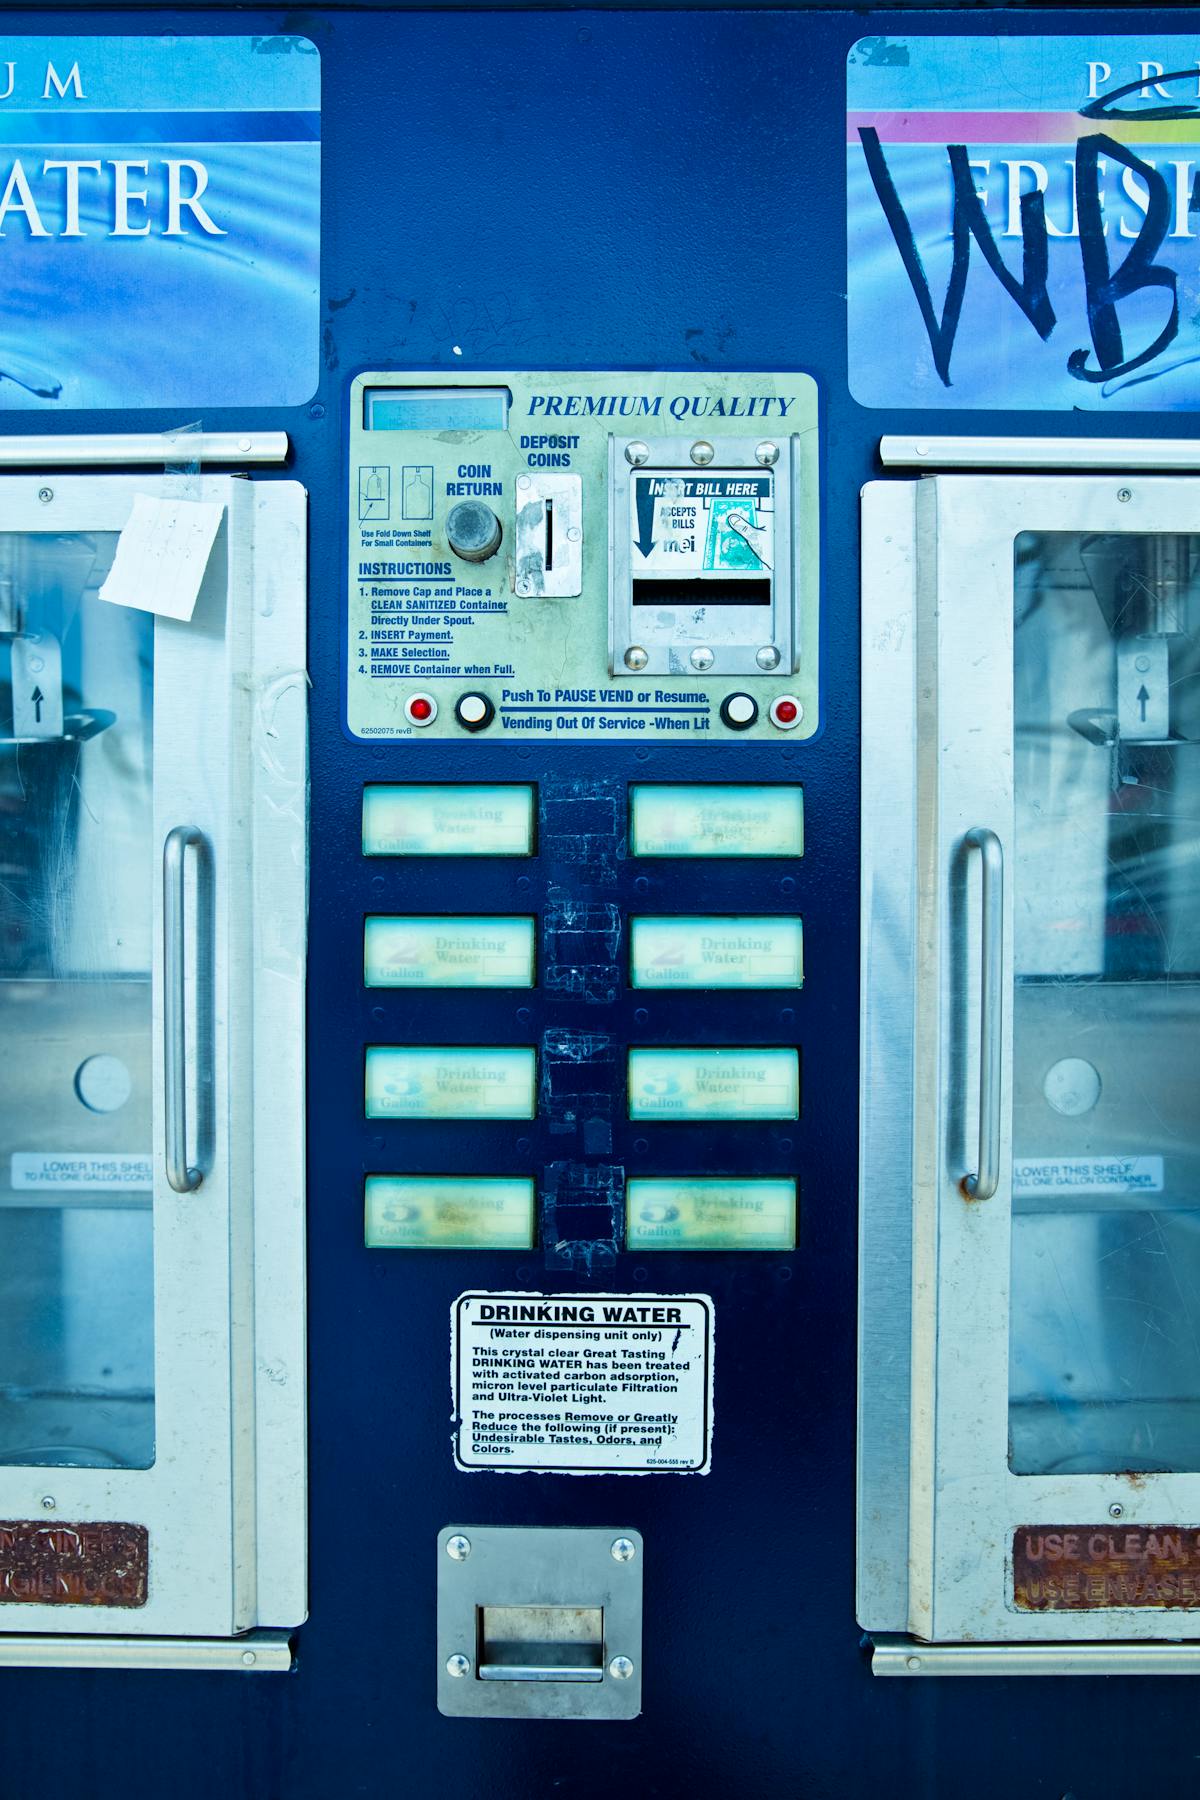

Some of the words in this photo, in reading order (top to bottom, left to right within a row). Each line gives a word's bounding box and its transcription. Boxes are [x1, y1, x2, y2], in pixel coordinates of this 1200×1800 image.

[1086, 61, 1200, 98] PR
[527, 396, 664, 416] PREMIUM
[669, 396, 796, 421] QUALITY
[521, 435, 579, 448] DEPOSIT
[528, 453, 570, 466] COINS
[458, 465, 491, 478] COIN
[447, 483, 502, 496] RETURN
[696, 483, 722, 495] BILL
[726, 483, 758, 495] HERE
[672, 519, 695, 529] BILLS
[663, 536, 695, 553] mei
[359, 563, 451, 575] INSTRUCTIONS
[360, 587, 368, 596] 1.
[372, 587, 410, 596] Remove
[413, 587, 431, 598] Cap
[435, 587, 452, 596] and
[456, 587, 482, 596] Place
[371, 600, 402, 609] CLEAN
[406, 600, 456, 609] SANITIZED
[460, 600, 507, 611] Container
[371, 616, 408, 626] Directly
[412, 616, 440, 624] Under
[444, 616, 474, 626] Spout.
[359, 631, 367, 639] 2.
[371, 630, 405, 639] INSERT
[409, 631, 453, 642] Payment.
[359, 648, 367, 657] 3.
[371, 648, 398, 657] MAKE
[402, 648, 449, 657] Selection.
[359, 665, 367, 673] 4.
[371, 665, 410, 673] REMOVE
[414, 665, 461, 673] Container
[464, 665, 490, 673] when
[494, 665, 515, 673] Full.
[503, 690, 533, 702] Push
[537, 690, 550, 701] To
[555, 690, 596, 702] PAUSE
[599, 690, 633, 702] VEND
[638, 693, 651, 702] or
[655, 691, 709, 703] Resume.
[502, 717, 552, 731] Vending
[557, 717, 578, 729] Out
[582, 717, 595, 729] Of
[599, 717, 645, 729] Service
[650, 717, 690, 729] -When
[694, 718, 710, 729] Lit
[435, 937, 506, 953] Drinking
[701, 937, 772, 953] Drinking
[436, 951, 480, 964] Water
[702, 952, 746, 965] Water
[379, 966, 424, 979] Gallon
[645, 967, 689, 980] Gallon
[435, 1066, 507, 1083] Drinking
[695, 1066, 765, 1083] Drinking
[436, 1081, 480, 1094] Water
[696, 1081, 740, 1093] Water
[639, 1096, 683, 1109] Gallon
[43, 1161, 87, 1172] LOWER
[91, 1162, 116, 1172] THIS
[1015, 1167, 1059, 1177] LOWER
[1063, 1165, 1089, 1175] THIS
[1093, 1164, 1133, 1174] SHELF
[636, 1225, 681, 1238] Gallon
[478, 1303, 594, 1323] DRINKING
[603, 1307, 681, 1322] WATER
[490, 1329, 530, 1339] (Water
[534, 1327, 602, 1341] dispensing
[605, 1331, 627, 1339] unit
[632, 1331, 661, 1342] only)
[473, 1347, 498, 1356] This
[500, 1349, 544, 1360] crystal
[549, 1349, 579, 1357] clear
[583, 1349, 616, 1358] Great
[621, 1350, 665, 1360] Tasting
[473, 1358, 535, 1368] DRINKING
[539, 1360, 582, 1368] WATER
[587, 1361, 607, 1369] has
[612, 1361, 641, 1369] been
[646, 1362, 689, 1370] treated
[473, 1370, 498, 1378] with
[503, 1371, 560, 1379] activated
[564, 1372, 606, 1380] carbon
[610, 1372, 678, 1384] adsorption,
[473, 1381, 513, 1390] micron
[518, 1382, 546, 1390] level
[551, 1383, 617, 1392] particulate
[622, 1383, 677, 1392] Filtration
[472, 1392, 494, 1400] and
[499, 1393, 567, 1402] Ultra-Violet
[572, 1394, 606, 1404] Light.
[472, 1411, 494, 1419] The
[499, 1413, 560, 1424] processes
[565, 1412, 613, 1421] Remove
[617, 1415, 630, 1423] or
[634, 1413, 678, 1424] Greatly
[473, 1422, 517, 1431] Reduce
[522, 1423, 541, 1431] the
[545, 1422, 601, 1434] following
[605, 1424, 617, 1434] (if
[621, 1423, 676, 1436] present):
[473, 1433, 544, 1443] Undesirable
[549, 1435, 592, 1445] Tastes,
[597, 1435, 636, 1445] Odors,
[640, 1436, 662, 1445] and
[472, 1444, 514, 1453] Colors.
[1025, 1534, 1080, 1561] USE
[1025, 1575, 1081, 1602] USE
